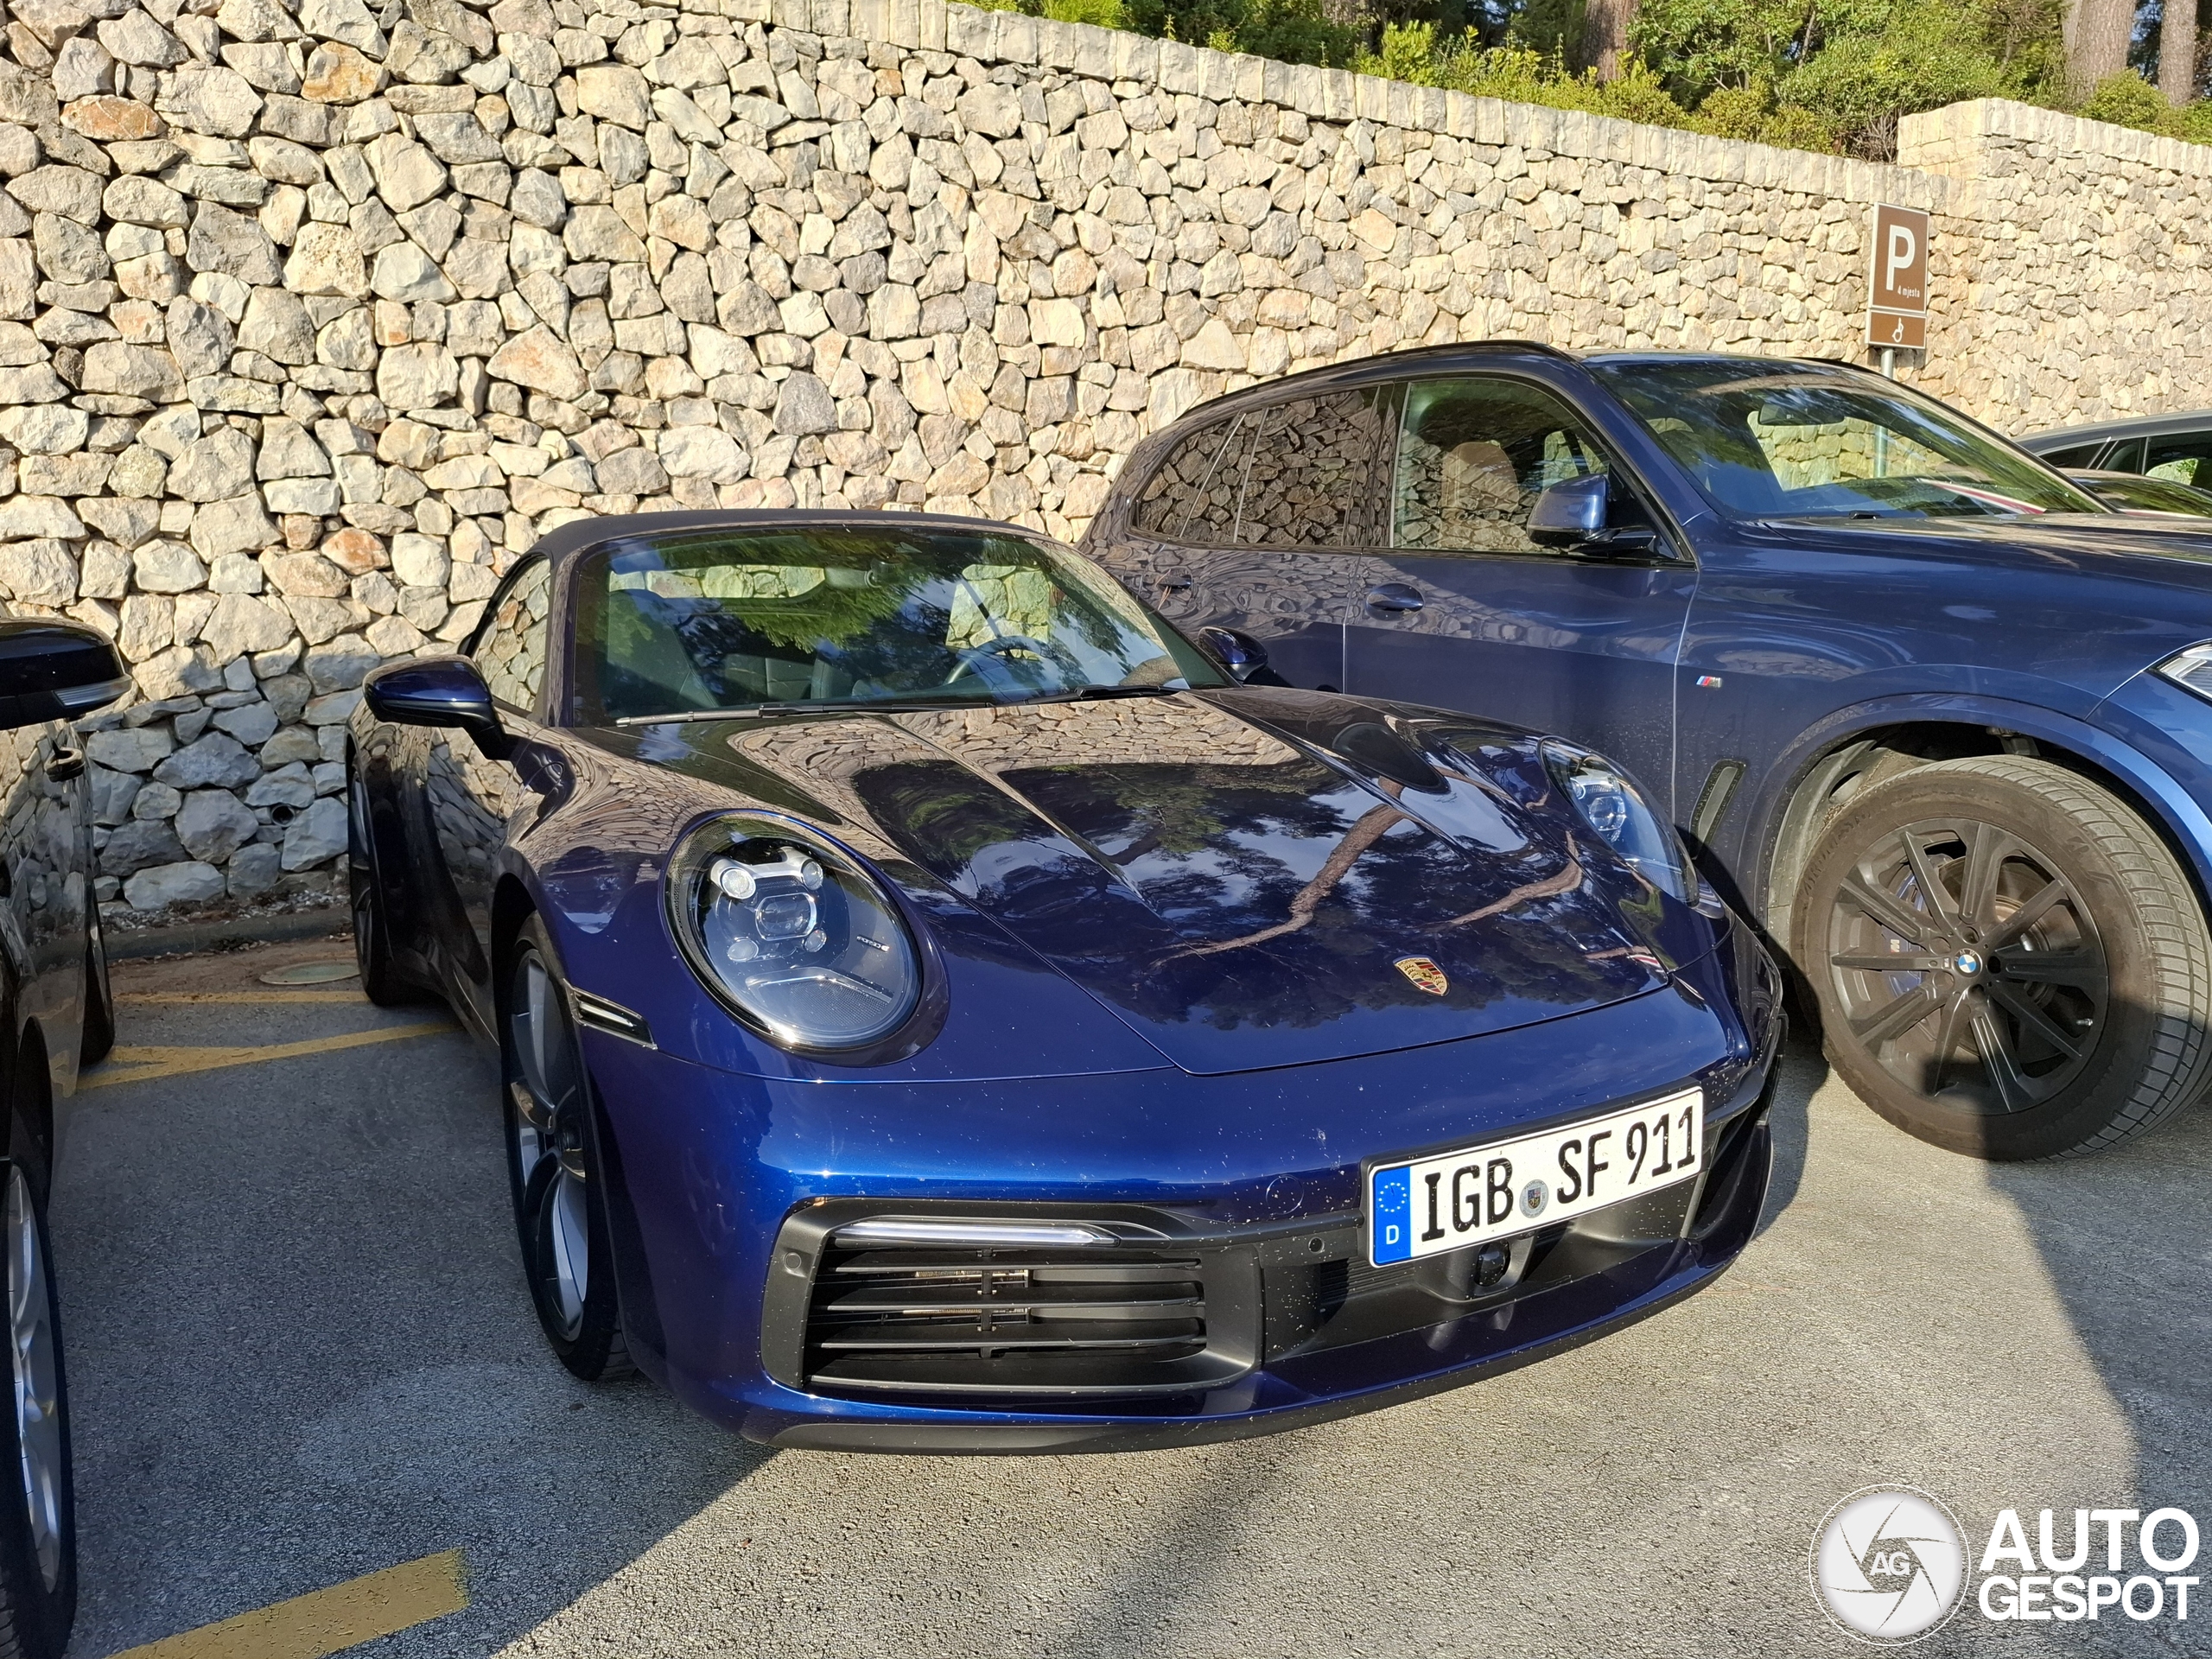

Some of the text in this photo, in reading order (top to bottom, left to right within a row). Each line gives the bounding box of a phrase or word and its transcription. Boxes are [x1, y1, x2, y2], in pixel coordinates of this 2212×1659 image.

[1886, 224, 1916, 291] P
[1902, 286, 1920, 299] mjesta
[1421, 1157, 1514, 1243] IGB
[1556, 1129, 1612, 1205] SF
[1625, 1105, 1695, 1186] 911
[1385, 1224, 1400, 1245] D
